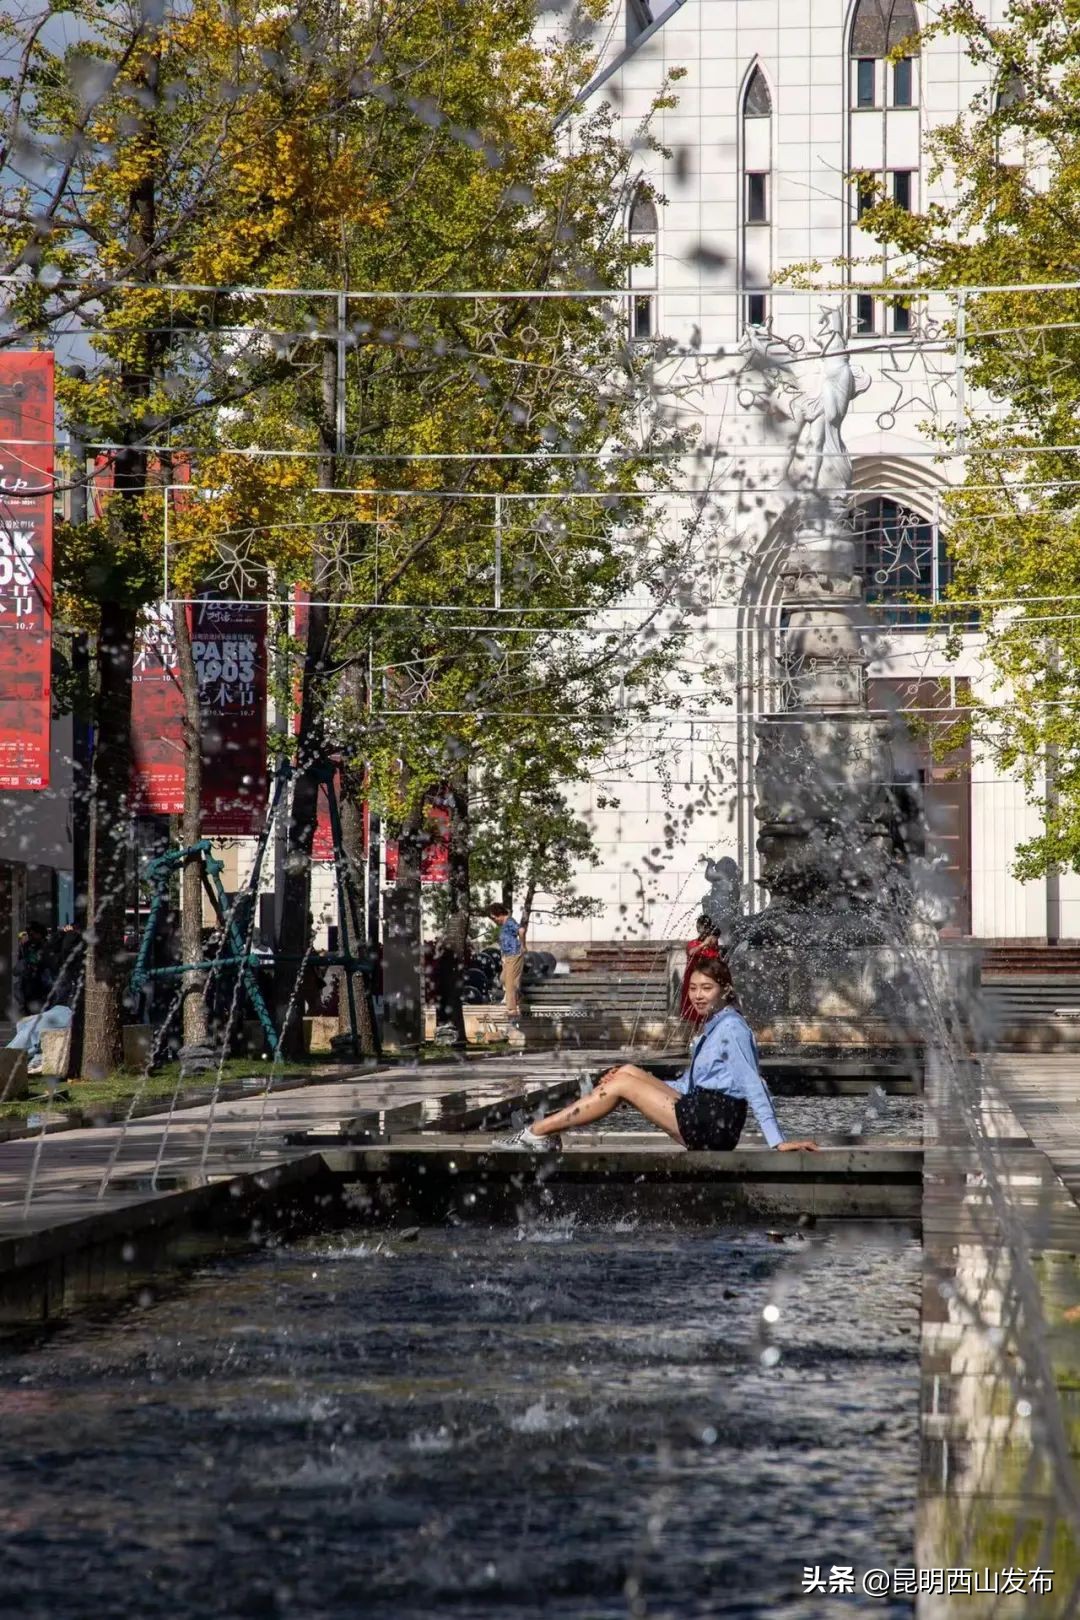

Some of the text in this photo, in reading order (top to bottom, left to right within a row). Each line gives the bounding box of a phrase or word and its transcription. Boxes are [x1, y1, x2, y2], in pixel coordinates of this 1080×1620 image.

[15, 622, 35, 630] 10.7
[133, 643, 177, 671] 术节
[192, 640, 257, 660] PARK
[195, 660, 255, 684] 1903
